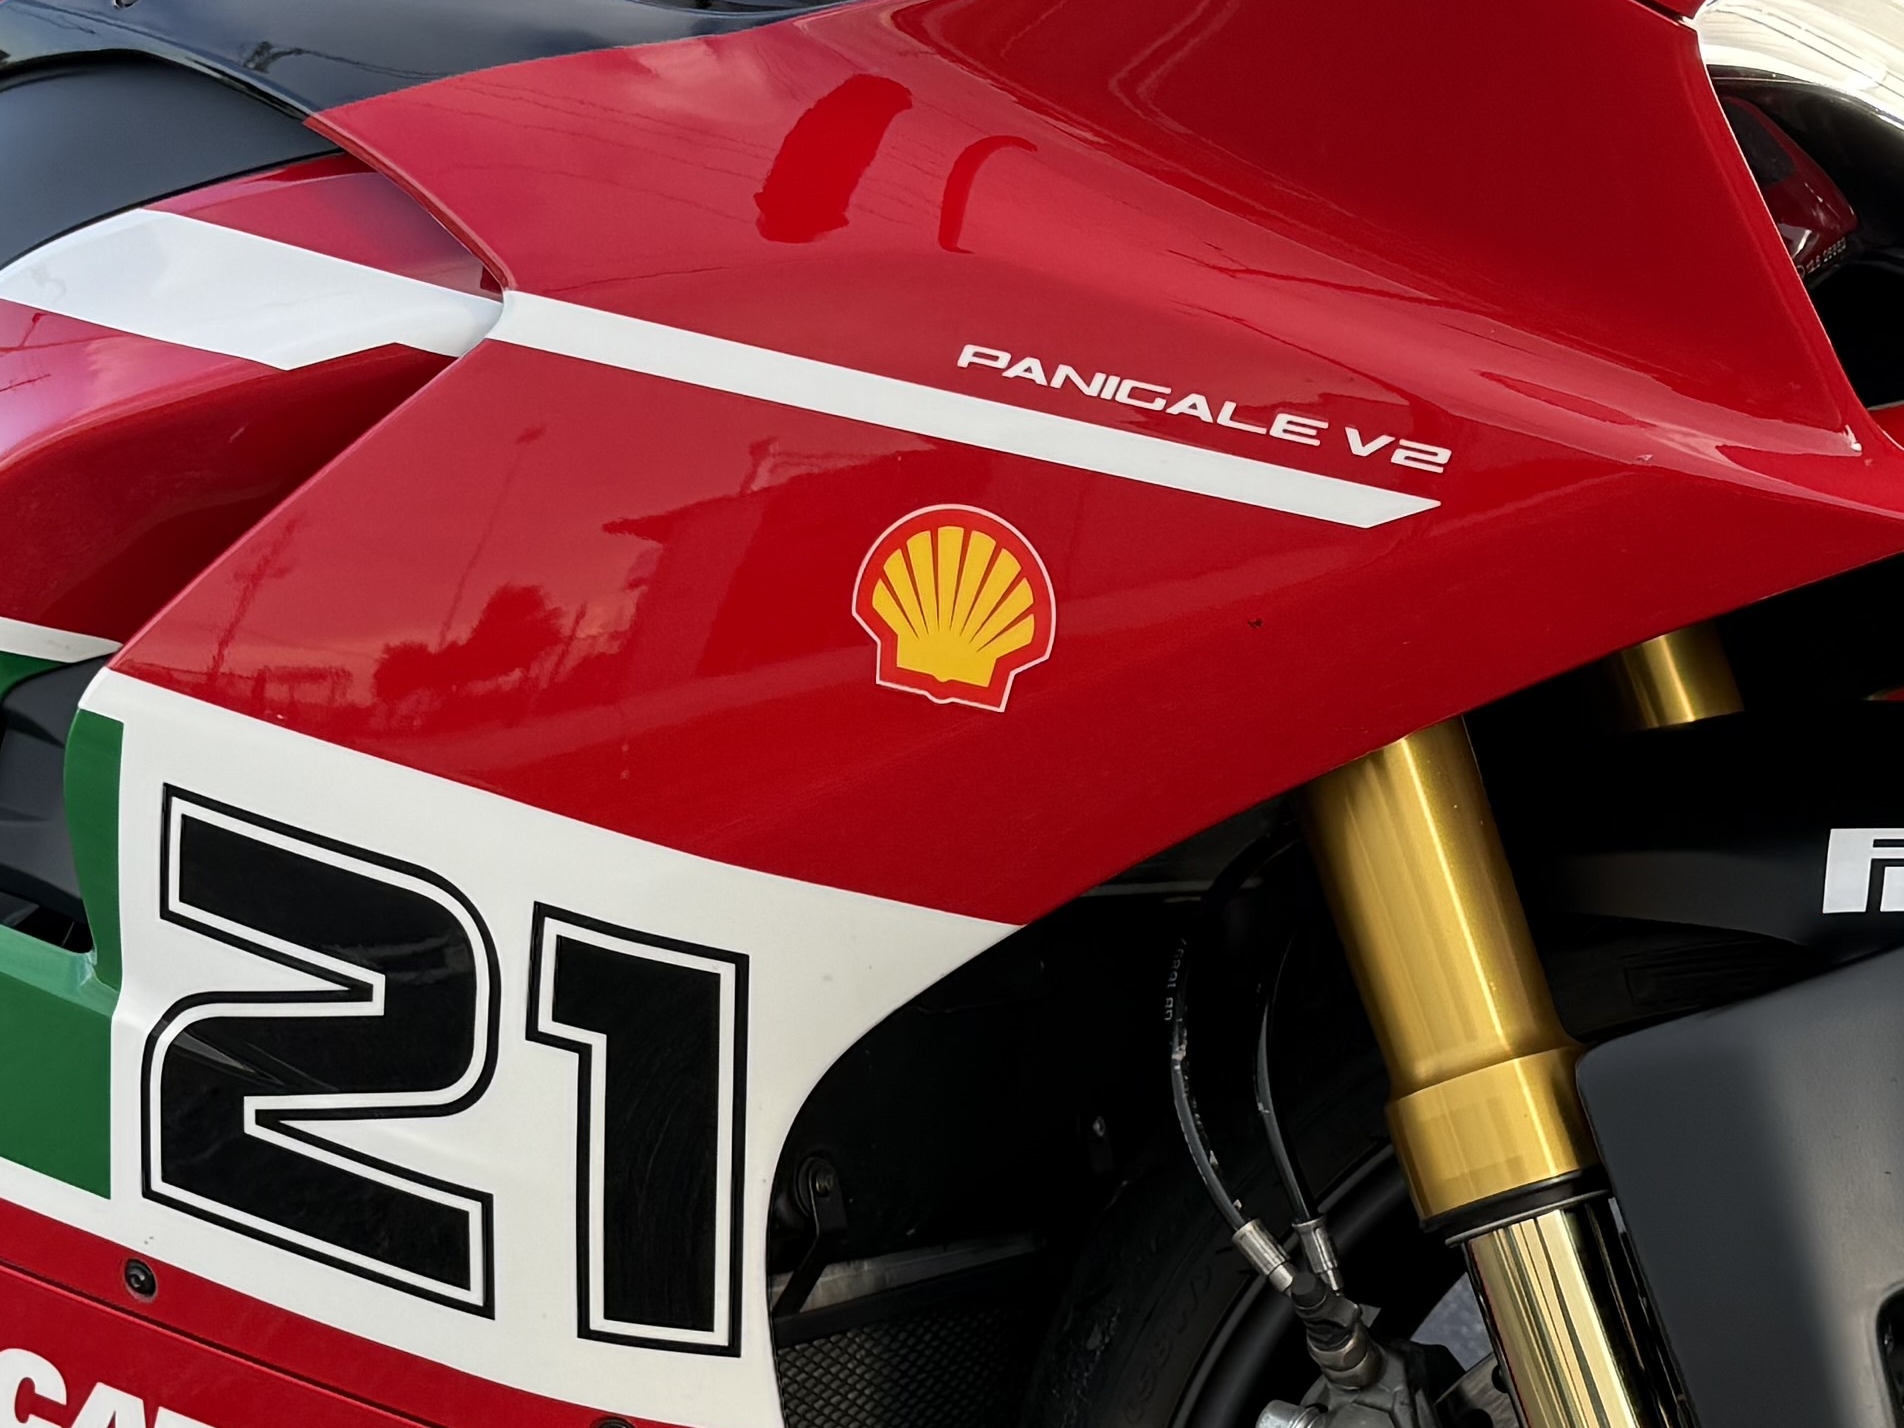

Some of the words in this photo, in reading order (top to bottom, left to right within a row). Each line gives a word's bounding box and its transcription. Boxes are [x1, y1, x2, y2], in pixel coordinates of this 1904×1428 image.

[956, 343, 1329, 448] PANIGALE
[1344, 425, 1453, 475] V2
[141, 782, 750, 1358] 21
